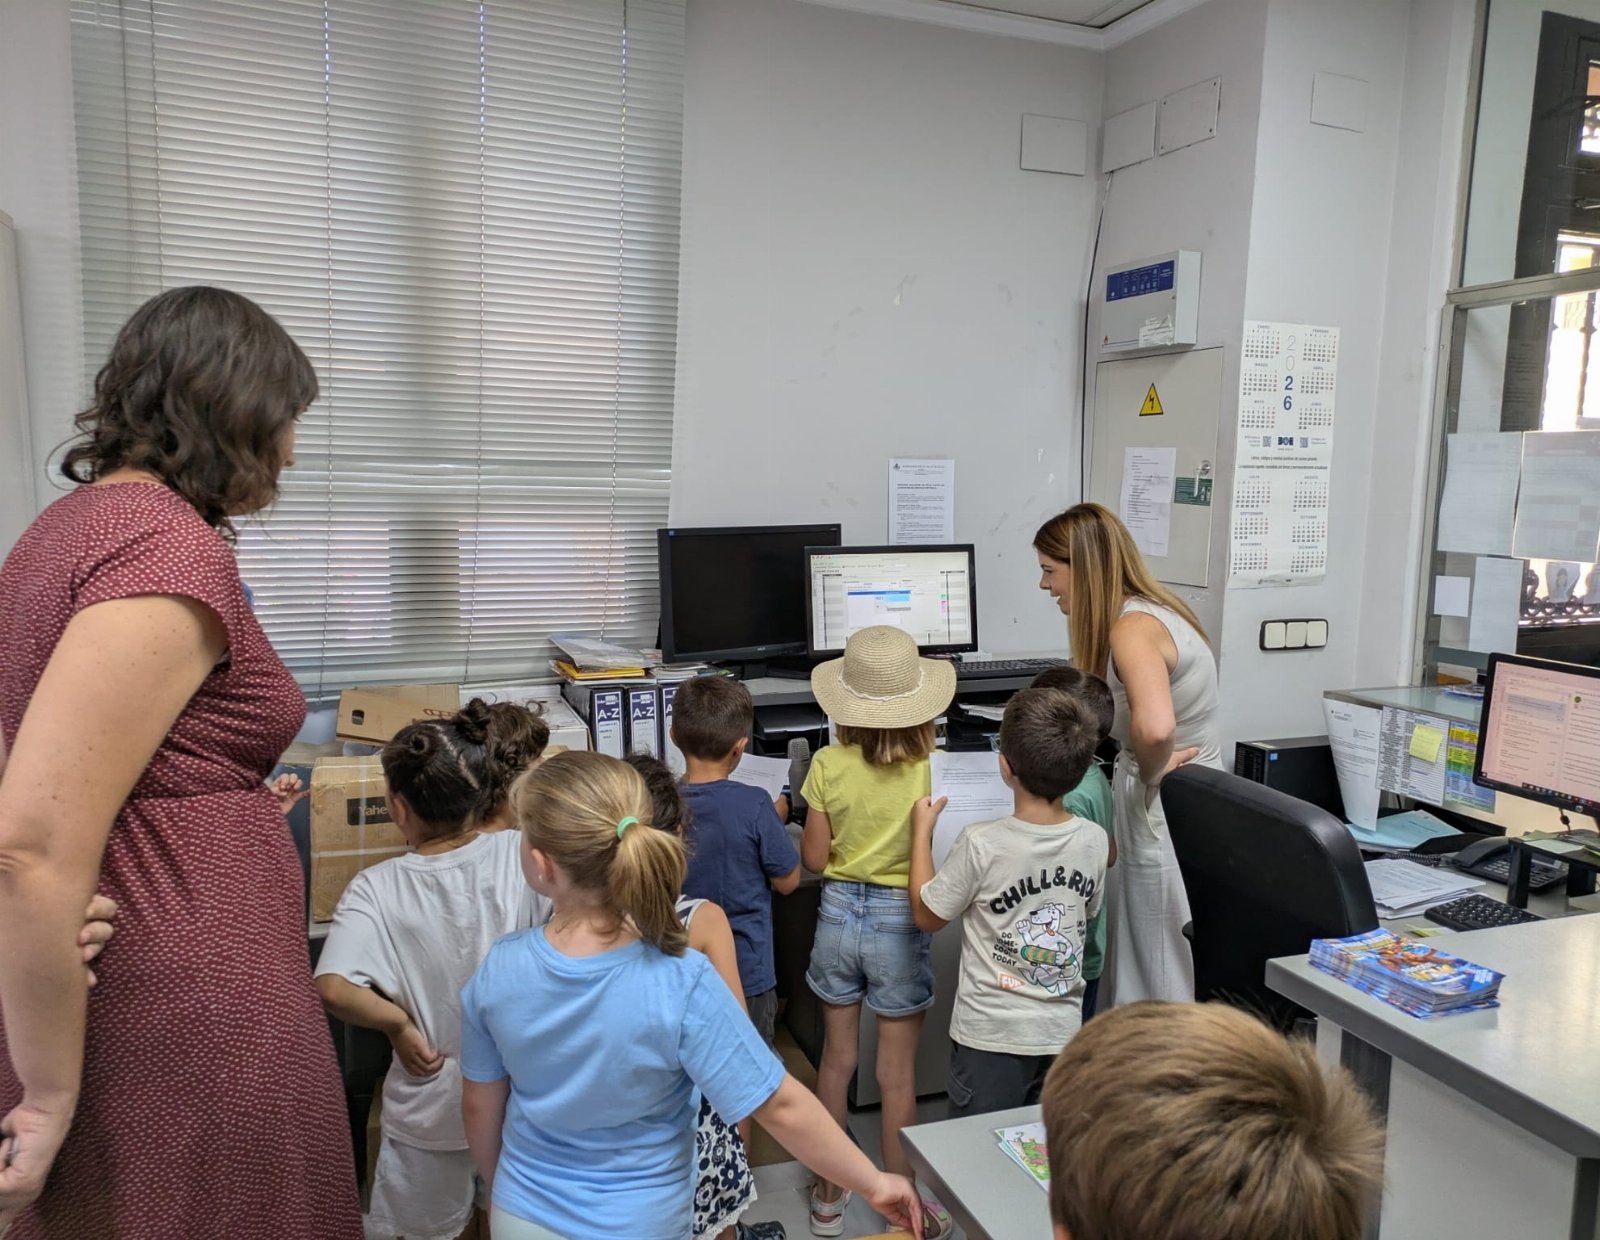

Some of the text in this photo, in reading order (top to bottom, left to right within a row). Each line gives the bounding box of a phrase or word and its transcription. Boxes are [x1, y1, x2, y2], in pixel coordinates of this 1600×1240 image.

[598, 708, 619, 720] A-Z
[633, 707, 654, 718] A-Z
[358, 804, 388, 816] Yahe
[1001, 931, 1013, 939] DO
[996, 936, 1019, 947] OME-
[992, 952, 1018, 967] TODAY
